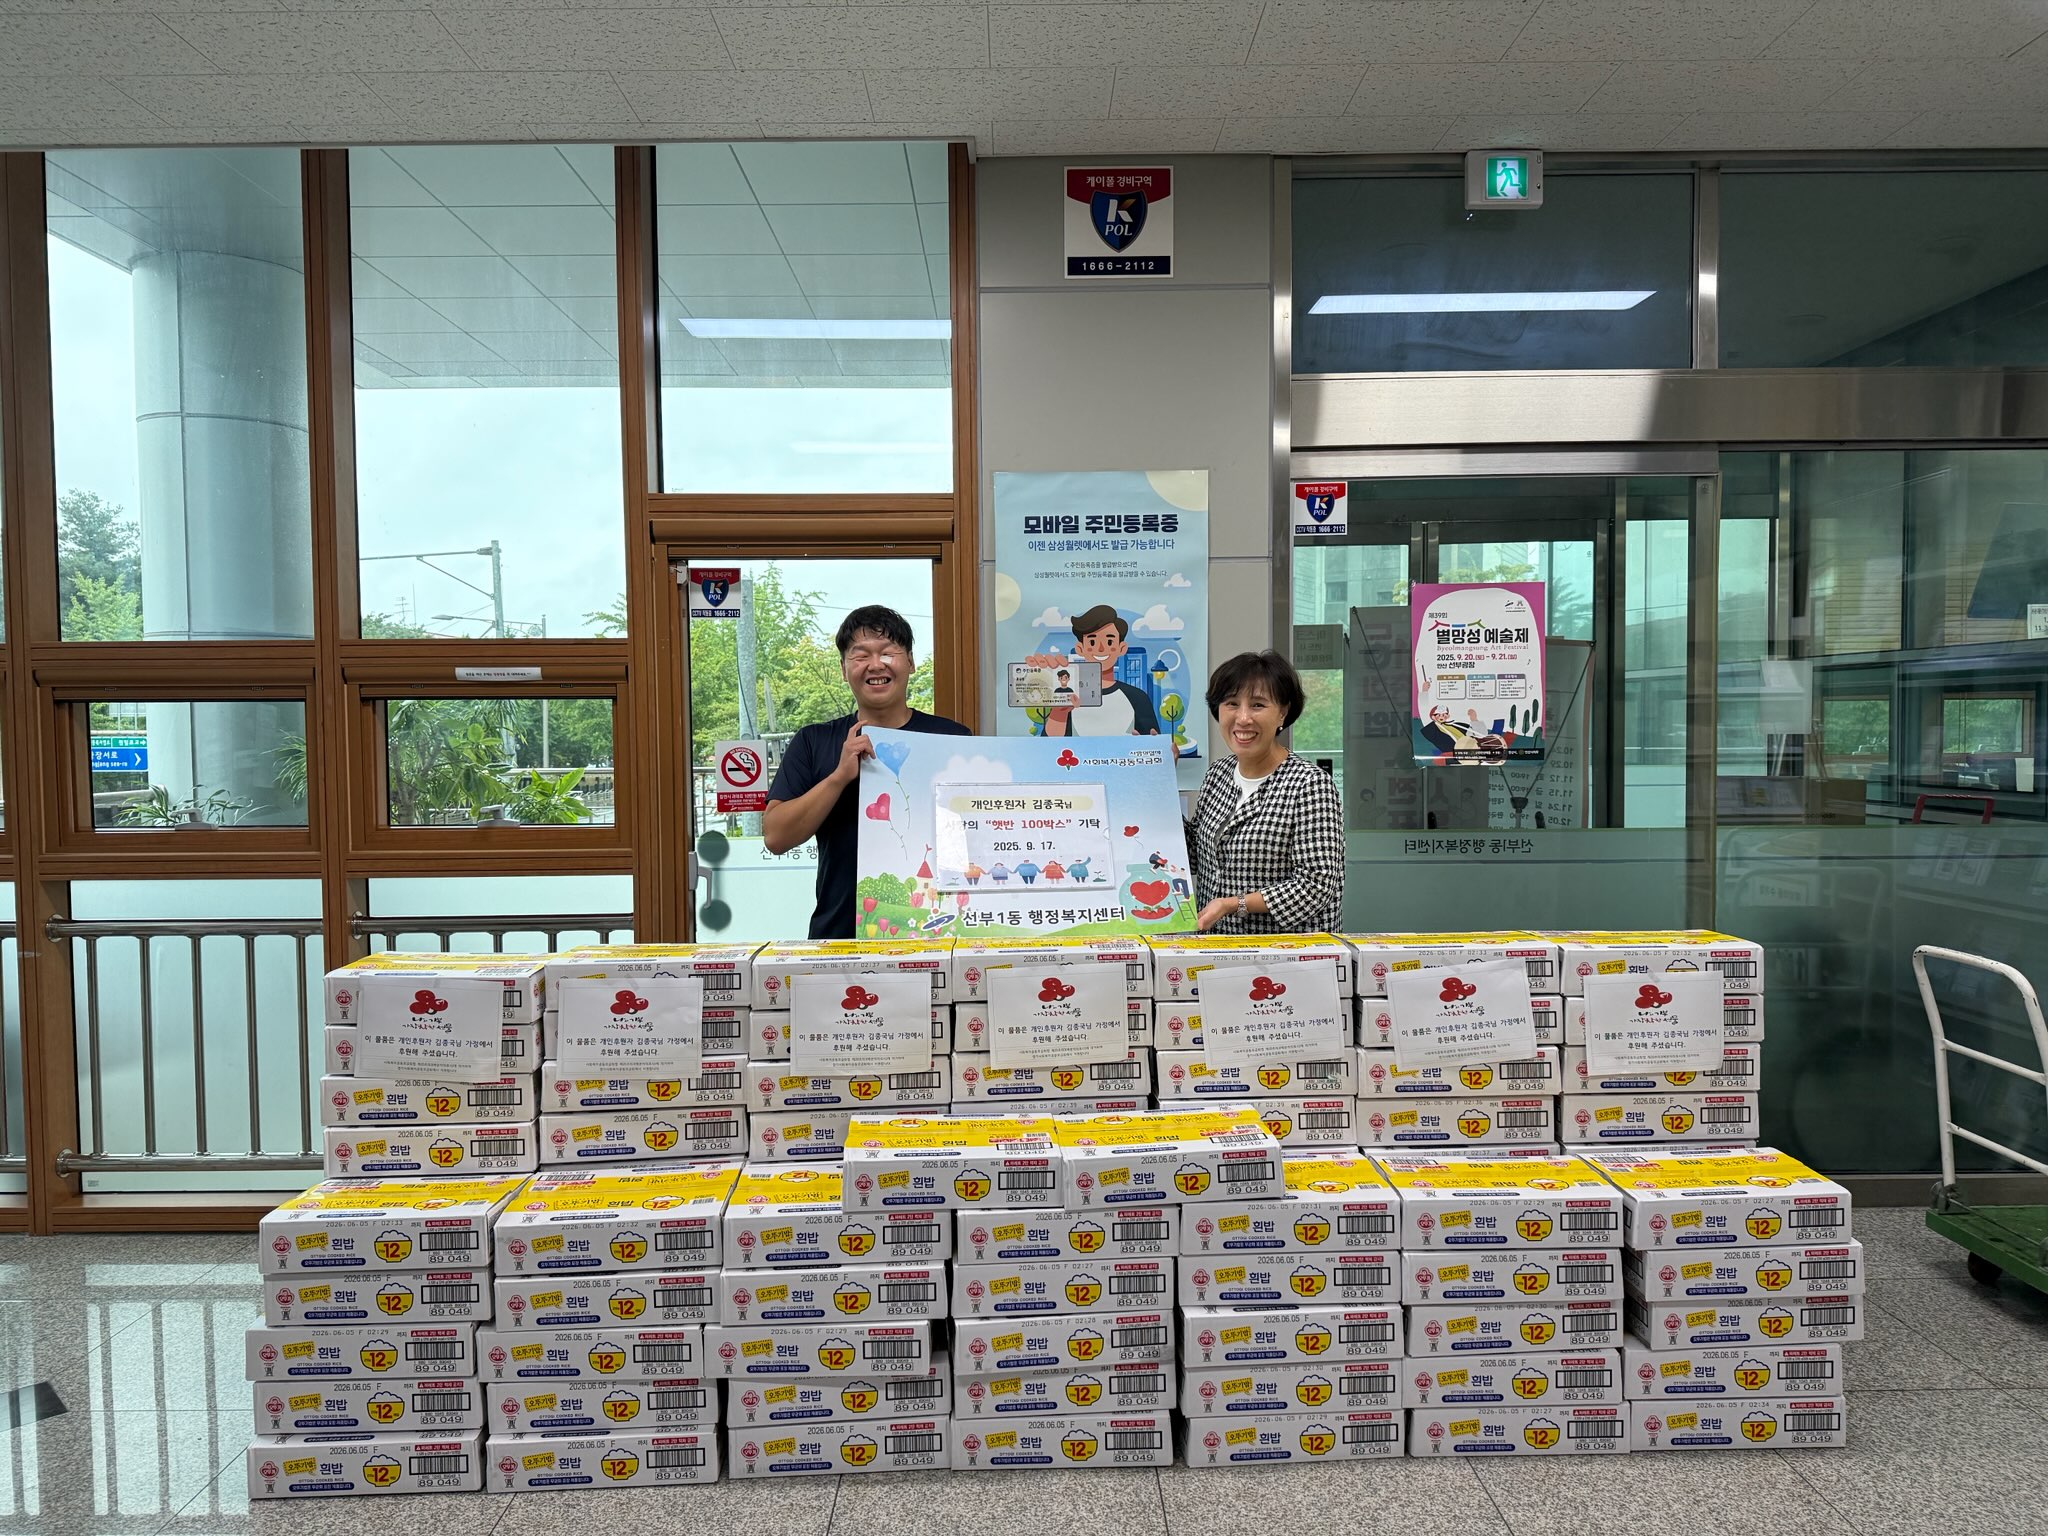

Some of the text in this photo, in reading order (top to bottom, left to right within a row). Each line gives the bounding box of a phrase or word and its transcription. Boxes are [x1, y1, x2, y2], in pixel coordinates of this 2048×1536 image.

[1086, 176, 1152, 187] 케이폴 경비구역
[1106, 199, 1136, 222] K
[1105, 224, 1132, 236] POL
[1082, 262, 1154, 270] 1666-2112
[1315, 497, 1329, 509] K
[1024, 514, 1178, 534] 모바일 주민등록증
[1028, 539, 1174, 551] 이젠 삼성월렛에서도 발급 가능합니다
[710, 583, 723, 593] K
[1437, 628, 1528, 644] 별망성 예술제
[1083, 757, 1162, 766] 사회복지공동모금회
[971, 799, 1072, 810] 개인후원자 김종국님
[1079, 818, 1100, 829] 기탁
[994, 841, 1056, 851] 2025. 9. 17.
[963, 906, 1125, 926] 선부1동 행정복지센터
[1222, 1026, 1240, 1034] 물품은
[1244, 1023, 1276, 1032] 개인후원자
[1280, 1020, 1305, 1029] 김종국님
[1309, 1018, 1335, 1026] 가정에서
[375, 1036, 395, 1044] 물품은
[398, 1037, 432, 1046] 개인후원자
[435, 1038, 462, 1047] 김종국님
[667, 1037, 694, 1045] 가정에서
[1604, 1032, 1624, 1040] 물품은
[600, 1048, 620, 1056] 후원해
[922, 1160, 959, 1169] 2026.06.05
[1141, 1155, 1178, 1164] 2026.06.05
[882, 1174, 935, 1188] 오뚜기밥 흰밥
[1102, 1171, 1155, 1184] 오뚜기밥 흰밥
[1183, 1176, 1199, 1191] 12
[962, 1182, 979, 1197] 12
[1227, 1184, 1267, 1195] 89 049
[1007, 1194, 1047, 1202] 89 049
[1705, 1216, 1727, 1228] 흰밥
[1754, 1221, 1770, 1235] 12
[300, 1236, 354, 1250] 오뚜기밥 흰밥
[383, 1243, 400, 1258] 12
